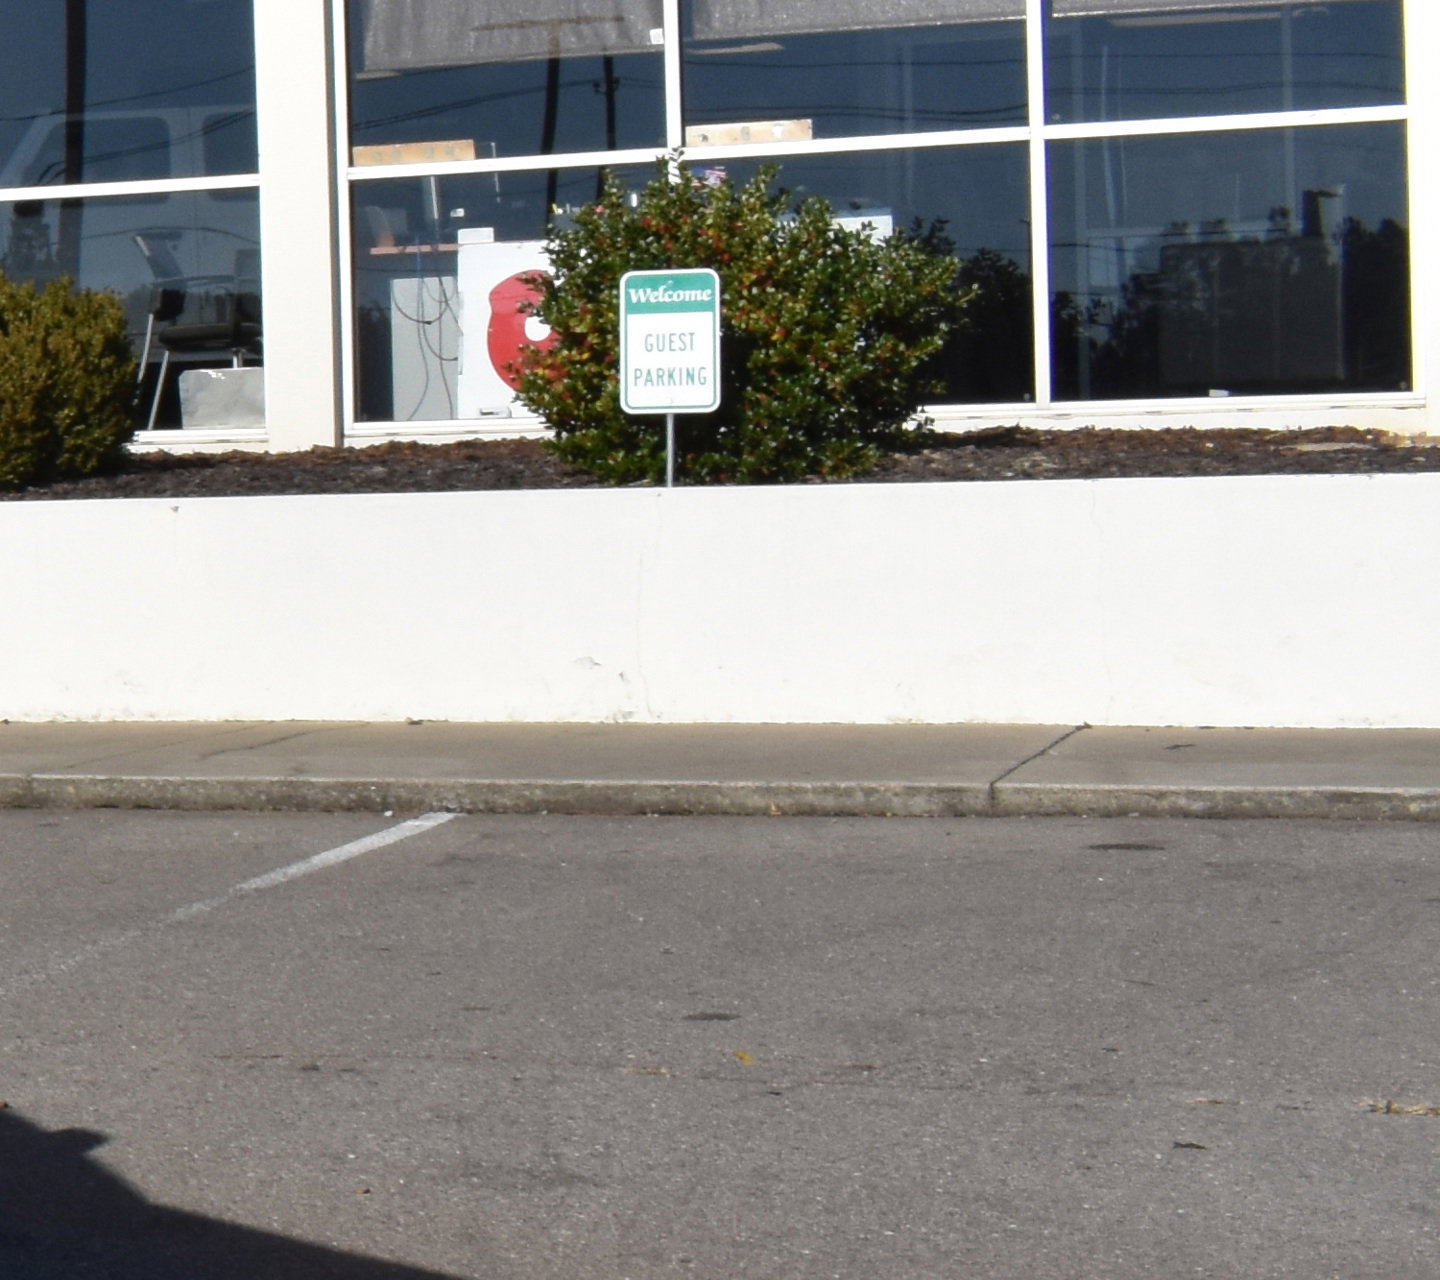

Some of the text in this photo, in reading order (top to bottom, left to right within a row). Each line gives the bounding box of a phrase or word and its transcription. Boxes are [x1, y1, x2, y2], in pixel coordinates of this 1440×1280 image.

[629, 280, 712, 304] Welcome
[644, 332, 696, 352] GUEST
[633, 366, 707, 387] PARKING
